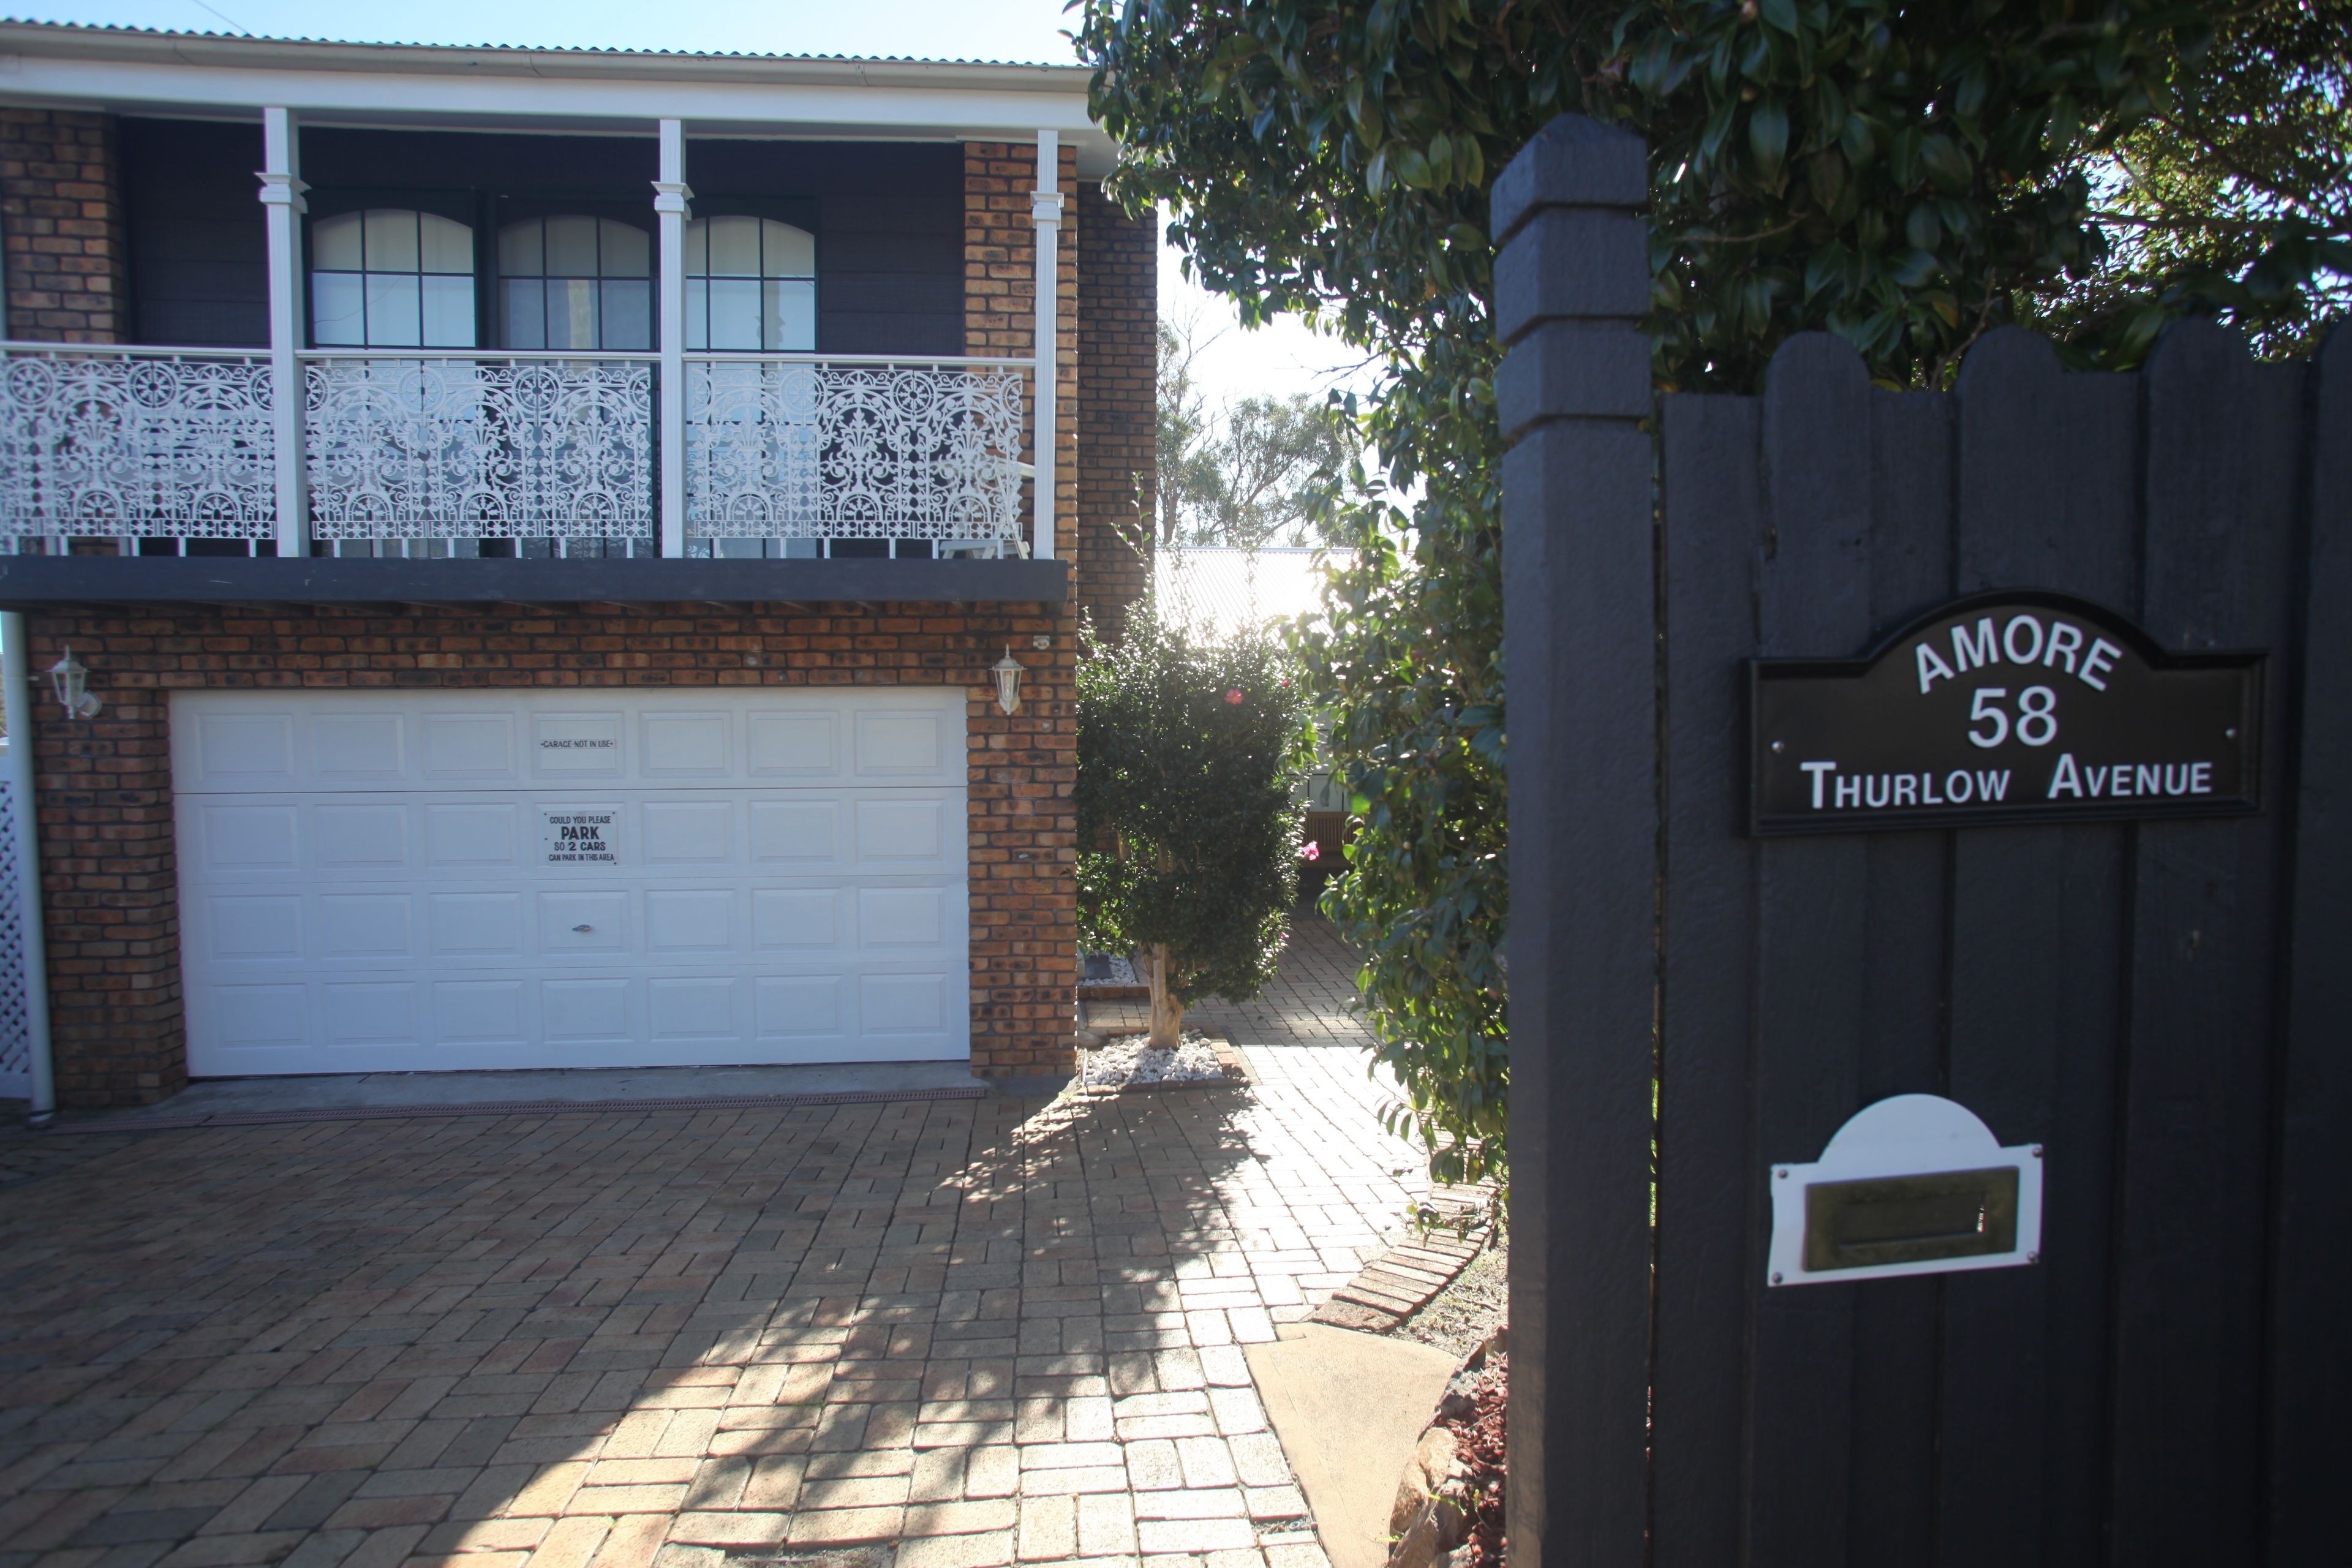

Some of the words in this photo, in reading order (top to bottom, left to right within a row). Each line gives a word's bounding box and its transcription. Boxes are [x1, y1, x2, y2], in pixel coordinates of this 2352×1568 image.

[1915, 614, 2123, 694] AMORE
[1968, 685, 2057, 748] 58
[588, 815, 611, 824] PLEASE
[561, 826, 600, 840] PARK
[554, 842, 565, 851] SO
[568, 842, 577, 851] 2
[580, 842, 606, 851] CARS
